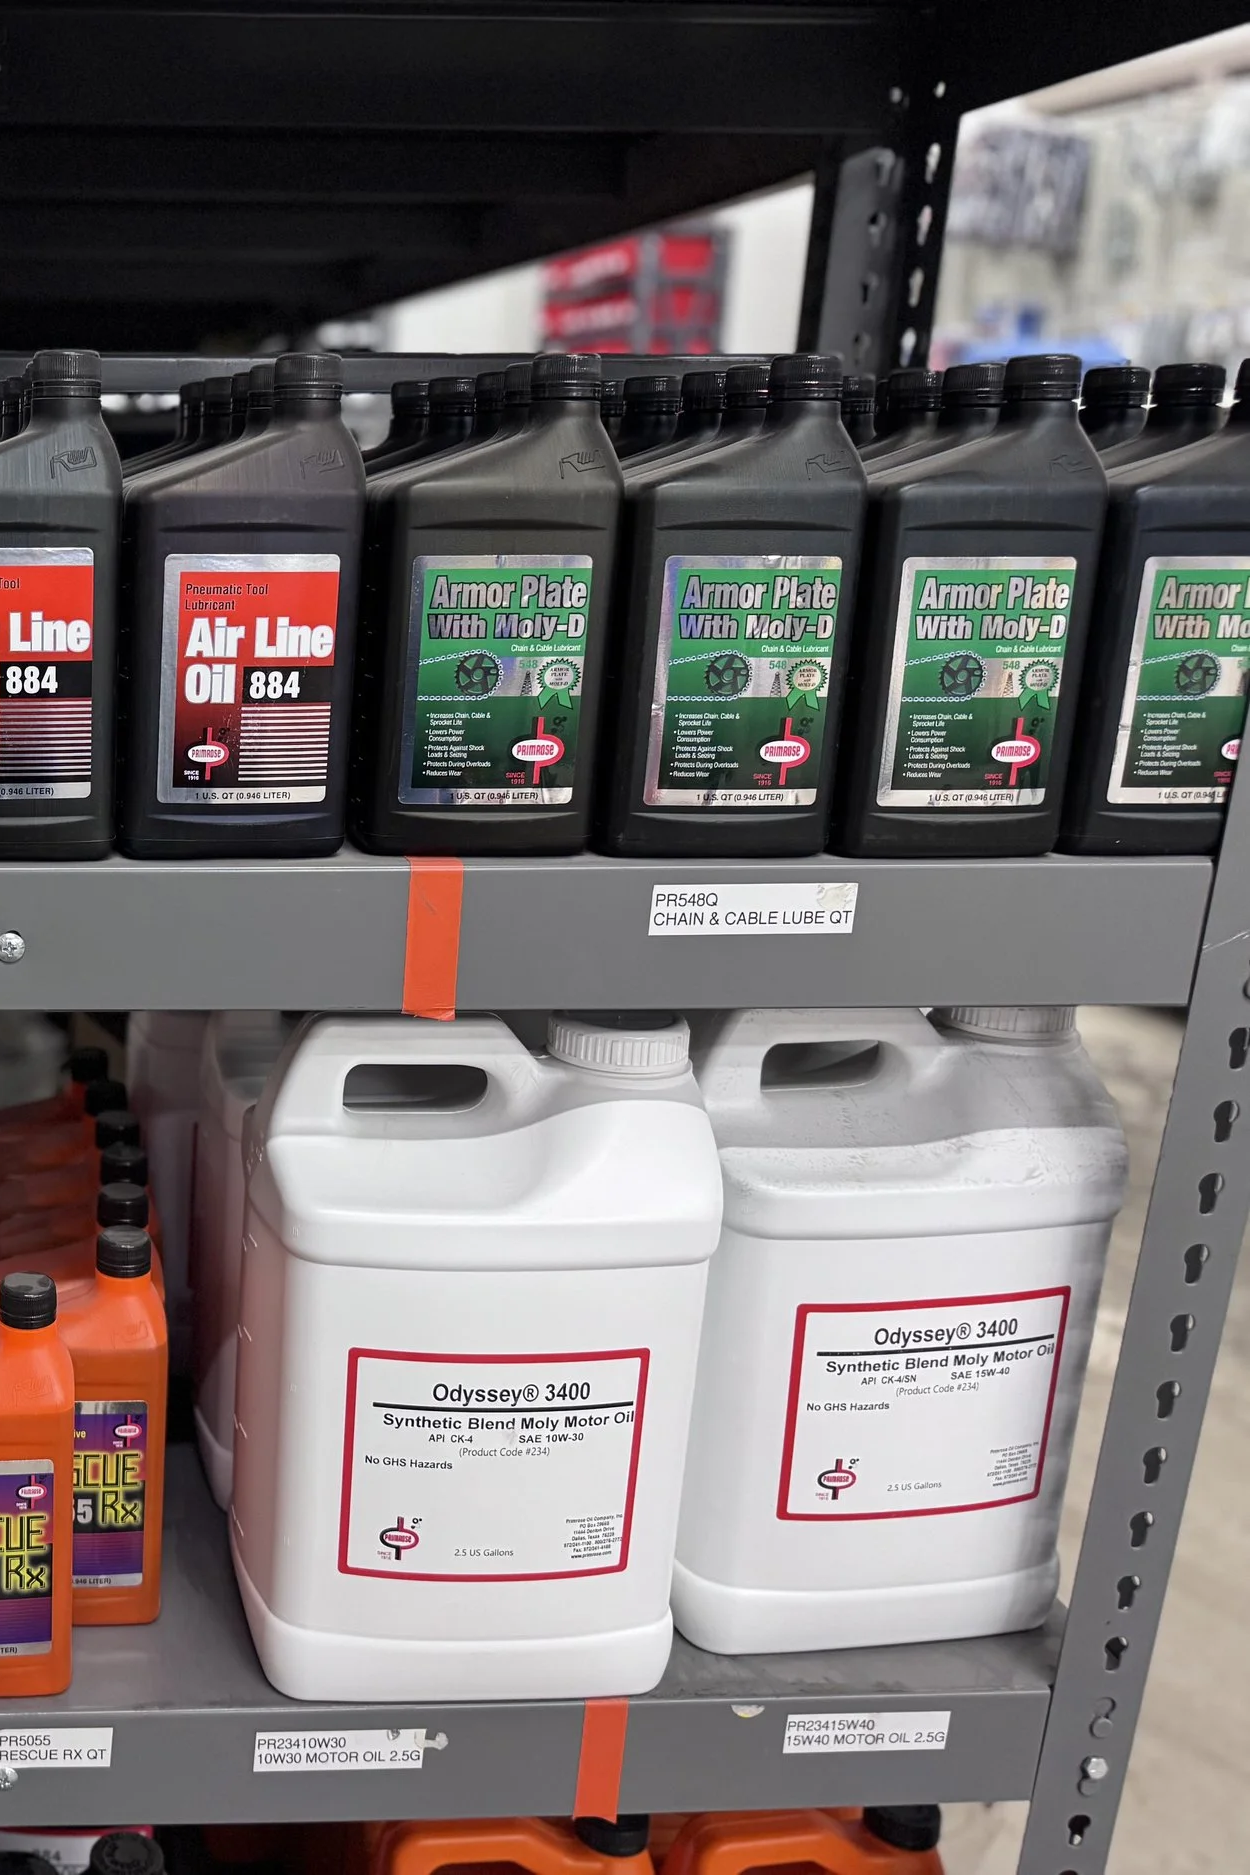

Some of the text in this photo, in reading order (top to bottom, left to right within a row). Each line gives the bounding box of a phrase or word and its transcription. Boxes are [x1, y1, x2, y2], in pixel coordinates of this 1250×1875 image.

[429, 575, 588, 609] Armor Plate
[681, 575, 837, 609] Armor Plate
[918, 576, 1070, 610] Armor Plate
[9, 611, 91, 653] Line
[428, 614, 585, 641] With Moly-D
[679, 614, 835, 642] With Moly-D
[916, 614, 1067, 642] With Moly-D
[184, 617, 334, 658] Air Line
[511, 644, 581, 652] Chain & Cable Lubricant
[6, 666, 58, 694] 884
[184, 663, 237, 704] Oil
[250, 671, 300, 699] 884
[655, 893, 718, 907] PR548Q
[653, 910, 852, 926] CHAIN & CABLE LUBE QT
[976, 1318, 1018, 1339] 3400
[826, 1343, 1054, 1374] Synthetic Blend Moly Motor Oil
[861, 1366, 1010, 1386] API CK-4/SN SAE 15W-40
[545, 1382, 590, 1402] 3400
[896, 1382, 979, 1398] (Product Code #234)
[806, 1401, 890, 1412] No GHS Hazards
[383, 1411, 635, 1432] Synthetic Blend Moly Motor Oil
[429, 1432, 584, 1444] API CK-4 SAE 10W-30
[459, 1446, 550, 1458] (Product Code #234)
[365, 1455, 453, 1470] No GHS Hazards
[887, 1481, 942, 1492] 2.5 US Gallons
[454, 1548, 513, 1557] 2.5 US Gallons
[788, 1720, 874, 1731] PR23415W40
[0, 1735, 50, 1746] PR5055
[257, 1737, 346, 1750] PR23410W30
[786, 1732, 945, 1746] 15W40 MOTOR OIL 2.5G
[0, 1749, 106, 1761] RESCUE RX QT
[258, 1751, 420, 1764] 10W30 MOTOR OIL 2.5G
